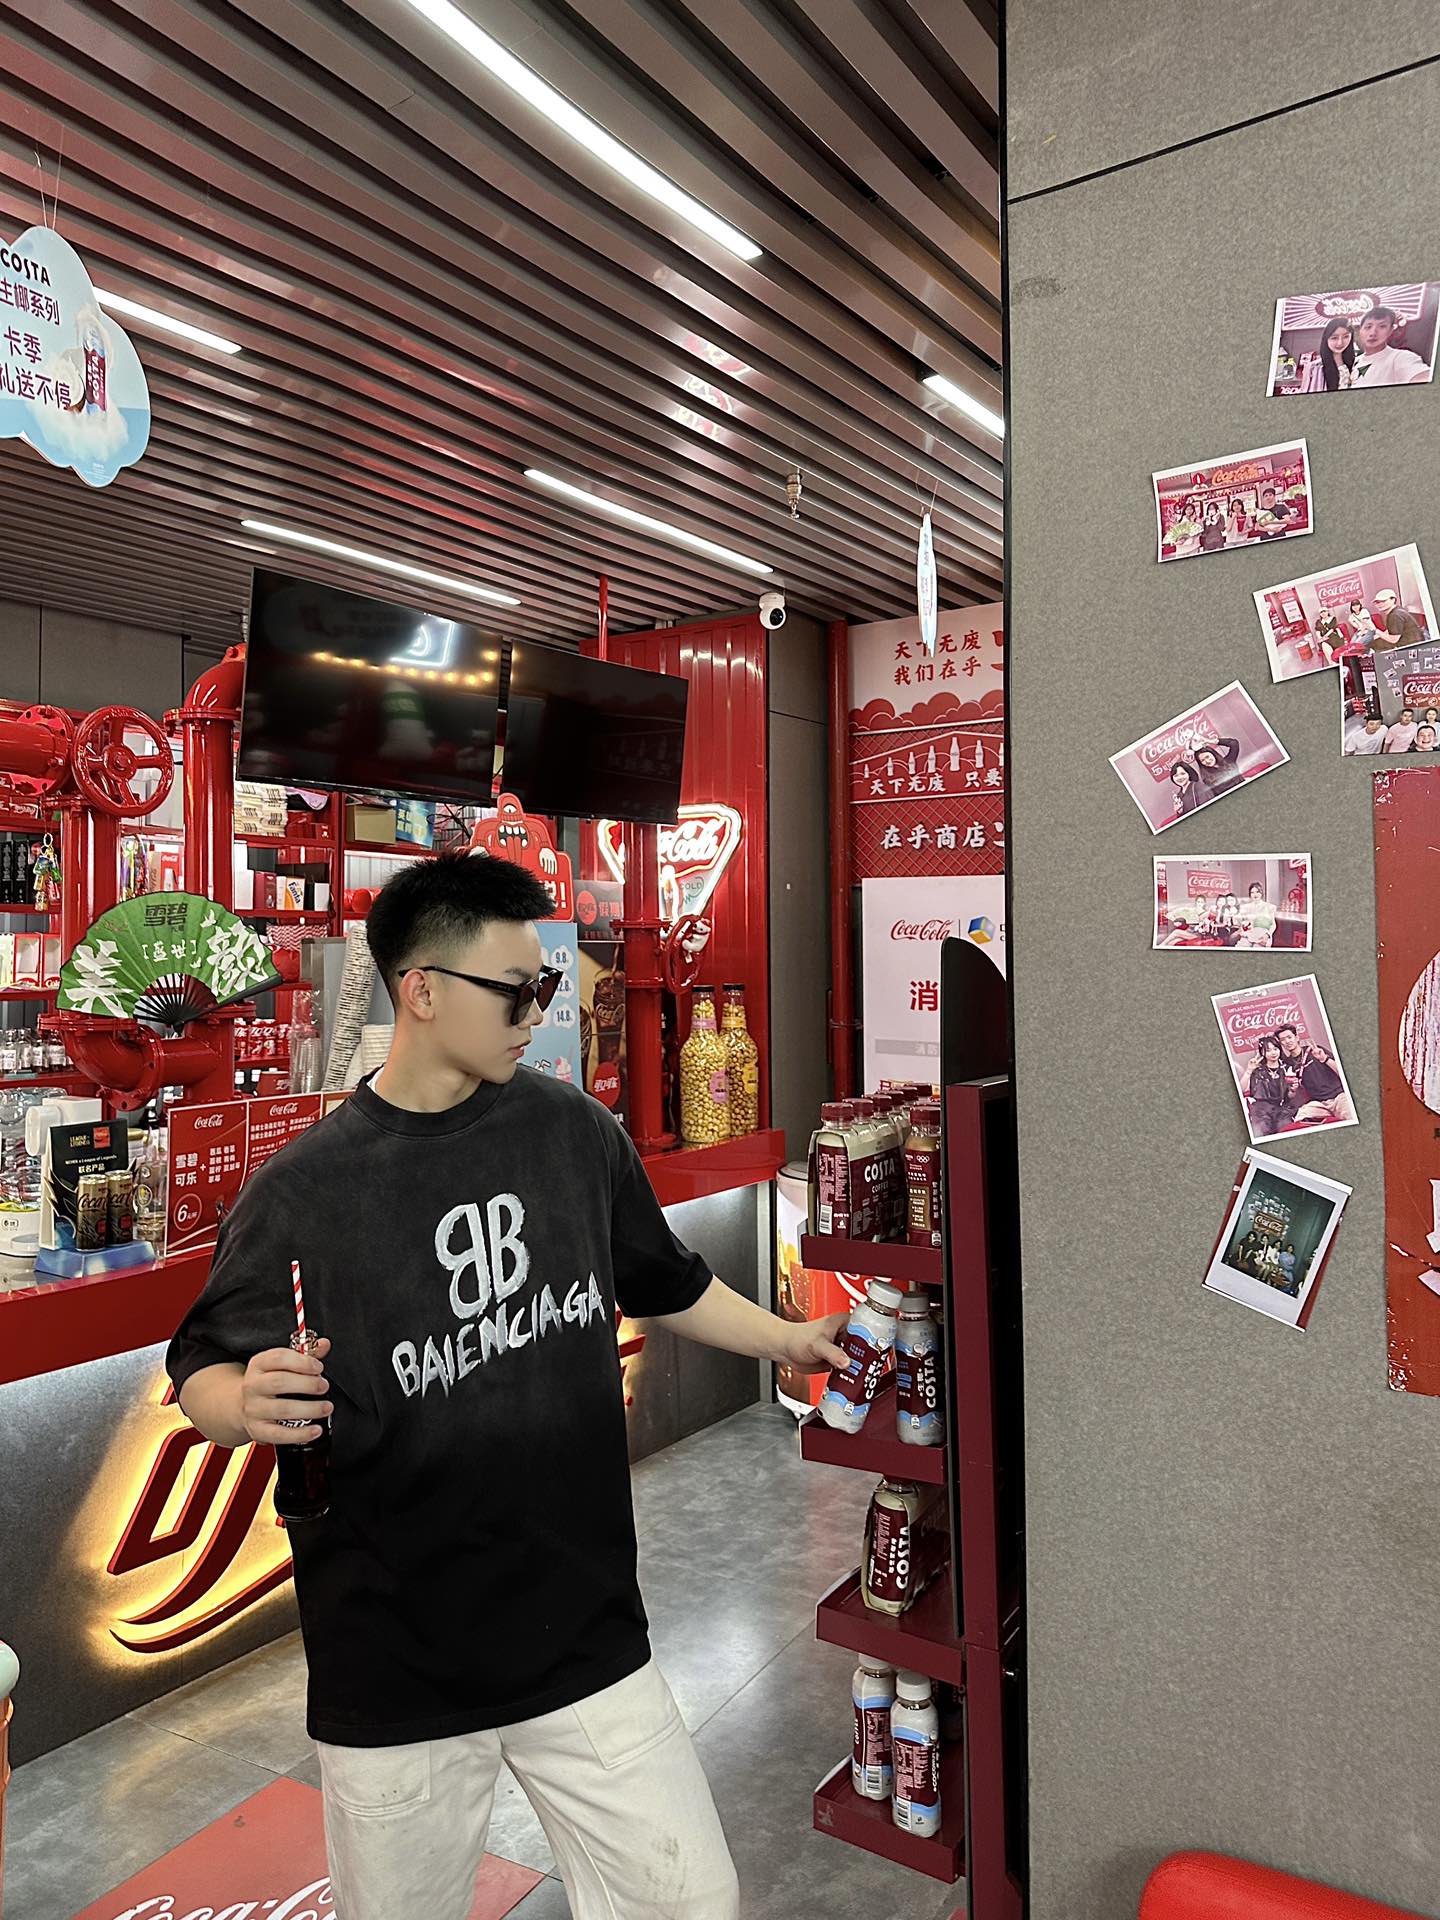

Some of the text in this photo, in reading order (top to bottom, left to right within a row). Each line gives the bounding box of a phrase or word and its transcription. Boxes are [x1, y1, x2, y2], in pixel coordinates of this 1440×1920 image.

[0, 248, 51, 287] COSTA
[4, 325, 43, 364] 卡季
[893, 655, 982, 686] 我们在乎
[869, 772, 947, 796] 天下无废
[879, 820, 987, 851] 在乎商店
[288, 881, 302, 904] Fanta
[143, 901, 189, 927] 雪碧
[890, 919, 954, 942] Coca-Cola
[64, 938, 135, 1018] 美
[1227, 1002, 1301, 1034] Coca-Cola
[175, 1153, 198, 1169] 雪碧
[864, 1157, 896, 1184] COSTA
[175, 1171, 198, 1188] 可乐
[177, 1204, 188, 1222] 6
[924, 1356, 936, 1409] COSTA
